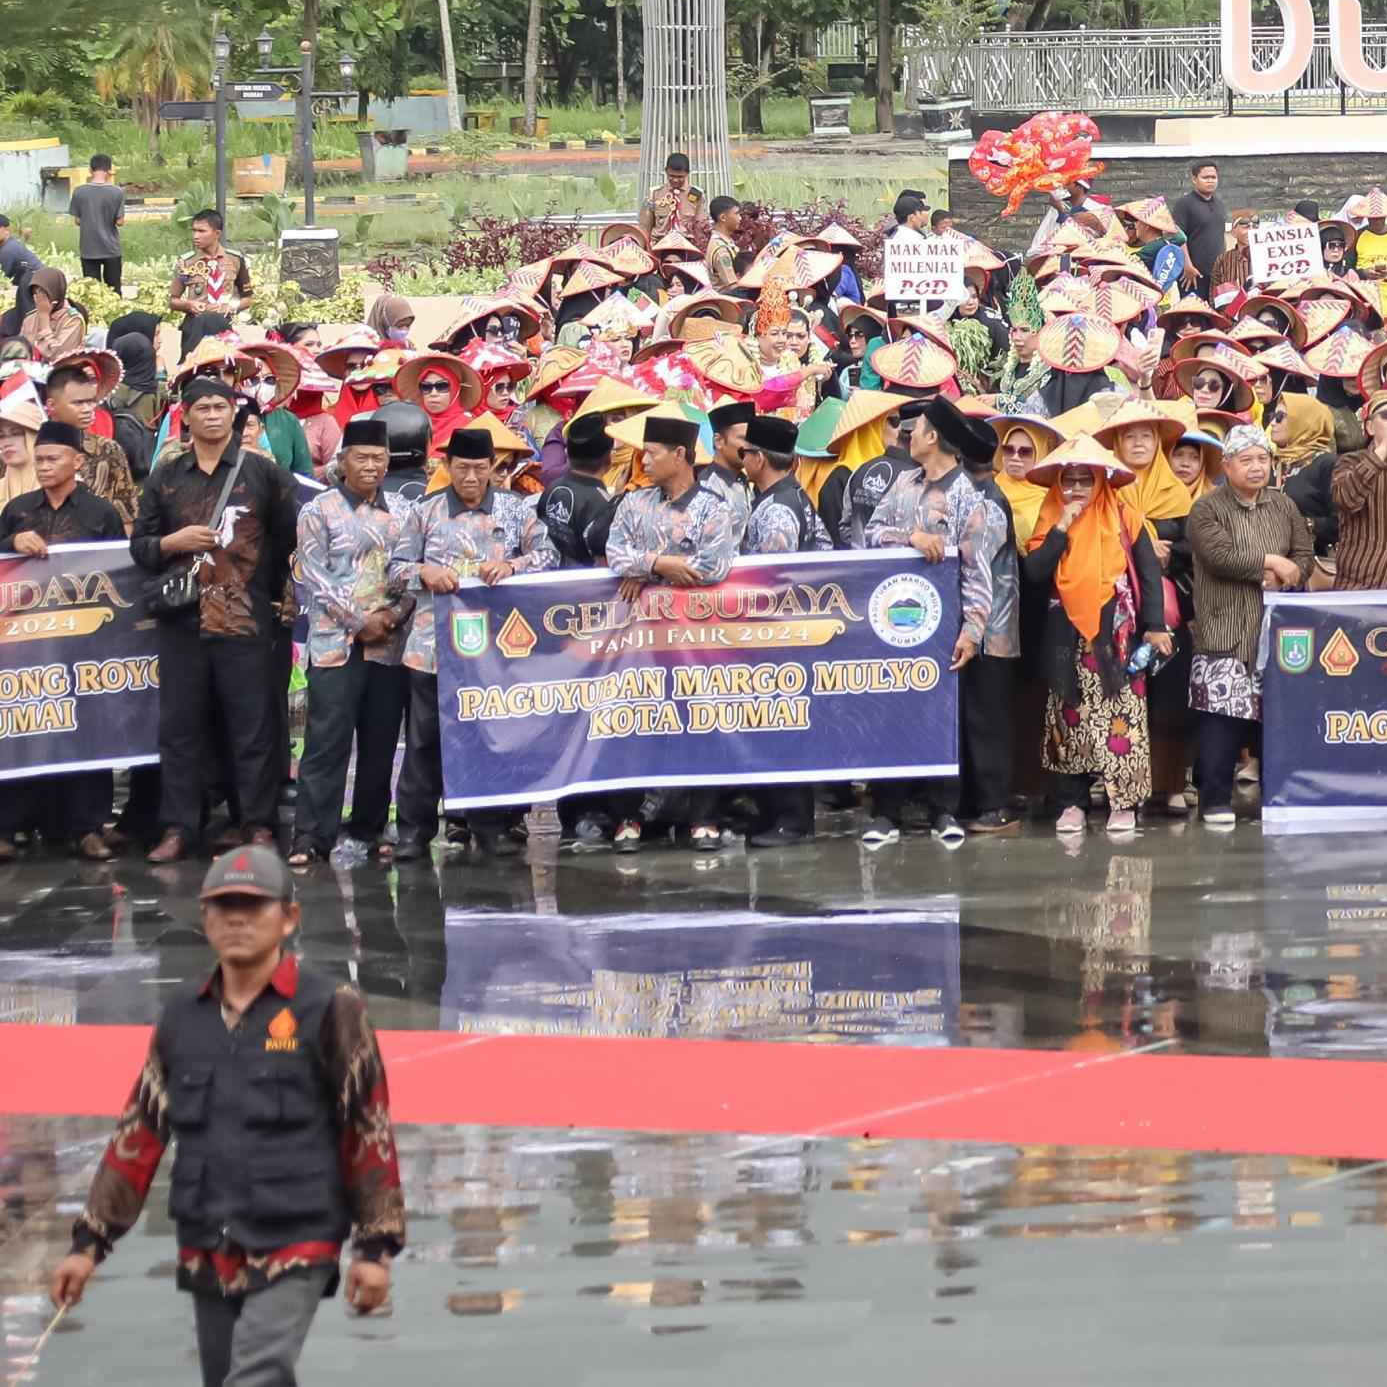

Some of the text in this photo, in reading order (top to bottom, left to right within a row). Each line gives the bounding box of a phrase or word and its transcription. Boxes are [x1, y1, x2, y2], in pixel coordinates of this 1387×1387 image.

[1254, 227, 1315, 244] LANSIA
[890, 244, 959, 256] MAK MAK
[1267, 244, 1305, 259] EXIS
[890, 262, 958, 274] MILENIAL
[1266, 259, 1311, 278] POD
[899, 280, 949, 295] POD
[543, 582, 865, 641] GELAR BUDAYA
[5, 616, 77, 636] 2024
[590, 625, 810, 655] PANJI FAIR 2024
[457, 656, 940, 721] PAGUYUBAN MARGO MULYO
[588, 697, 811, 741] KOTA DUMAI
